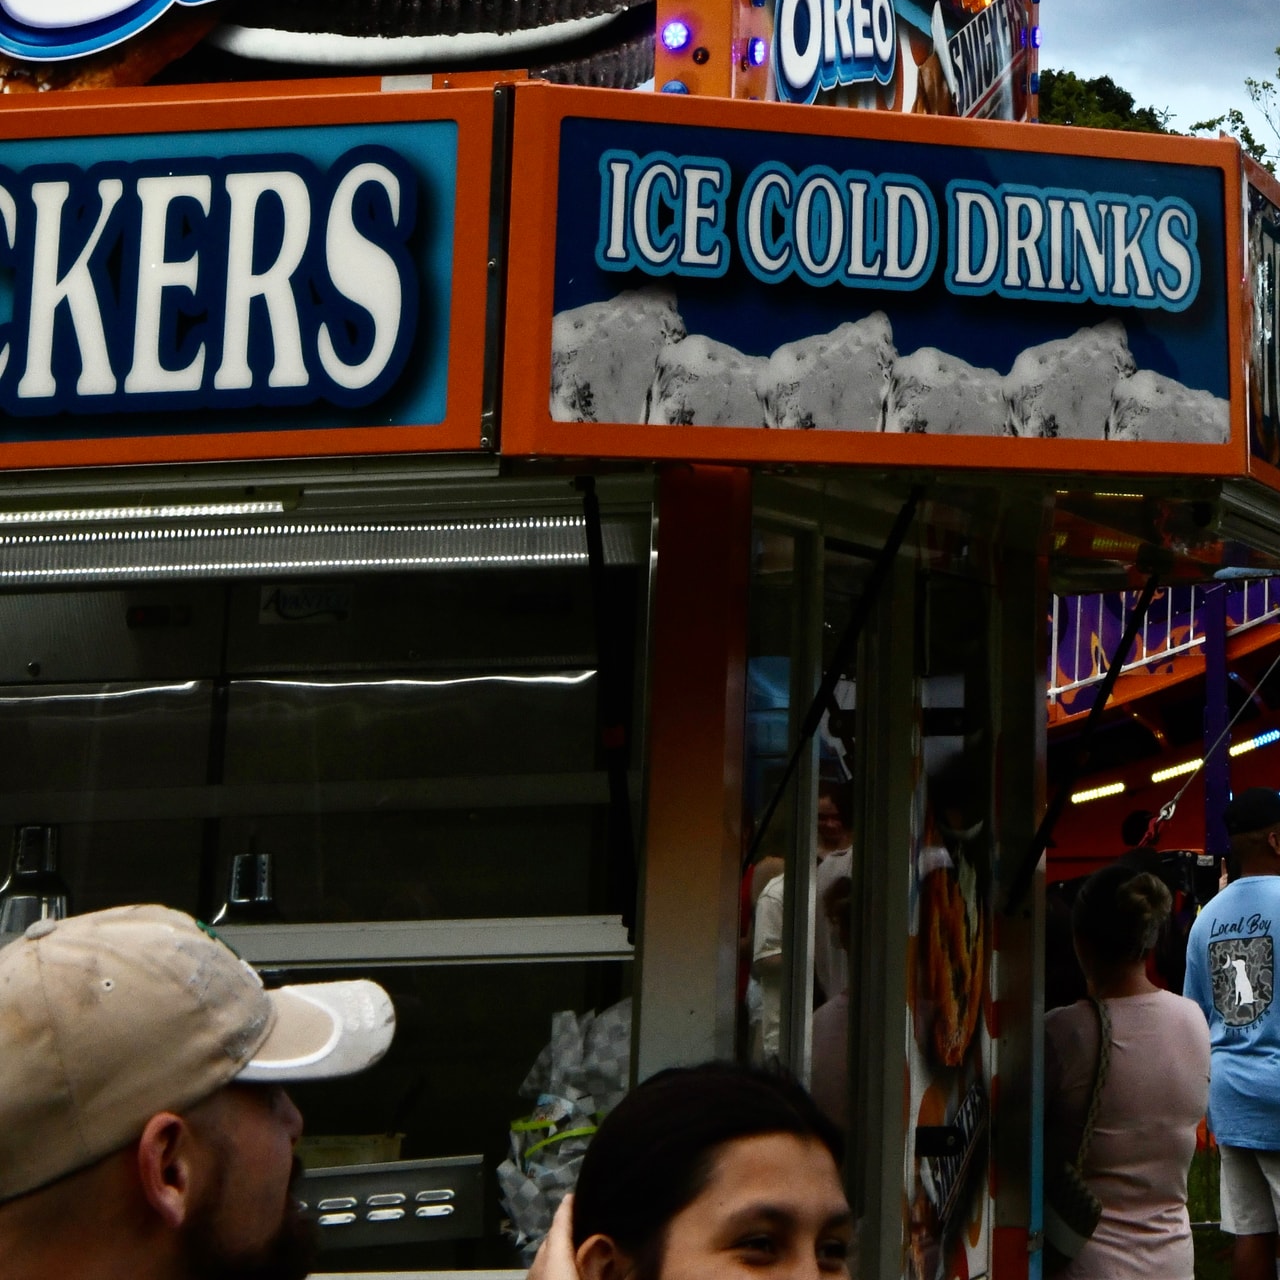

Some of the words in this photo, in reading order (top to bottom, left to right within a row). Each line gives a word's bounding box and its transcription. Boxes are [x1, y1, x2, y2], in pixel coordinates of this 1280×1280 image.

[0, 162, 403, 399] KERS
[606, 160, 723, 267] ICE
[747, 172, 930, 282] COLD
[953, 189, 1198, 302] DRINKS
[1210, 916, 1244, 939] Local
[1247, 913, 1272, 937] Boy
